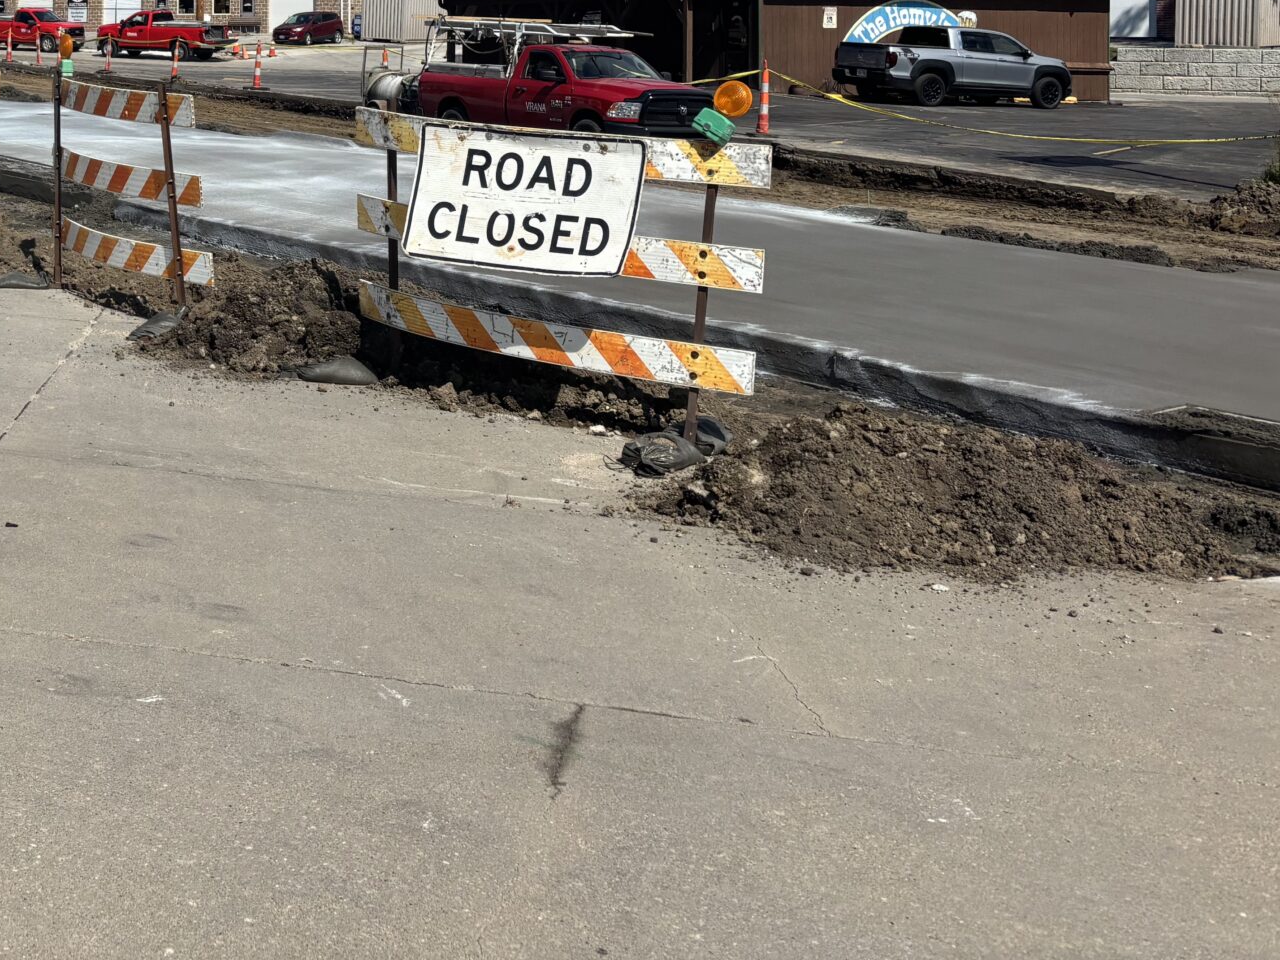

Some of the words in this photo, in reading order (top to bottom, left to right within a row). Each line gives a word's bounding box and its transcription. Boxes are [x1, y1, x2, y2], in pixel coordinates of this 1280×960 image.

[854, 14, 887, 43] The
[885, 4, 938, 26] Homy
[526, 101, 546, 113] VRANA
[462, 148, 593, 198] ROAD
[427, 201, 610, 257] CLOSED
